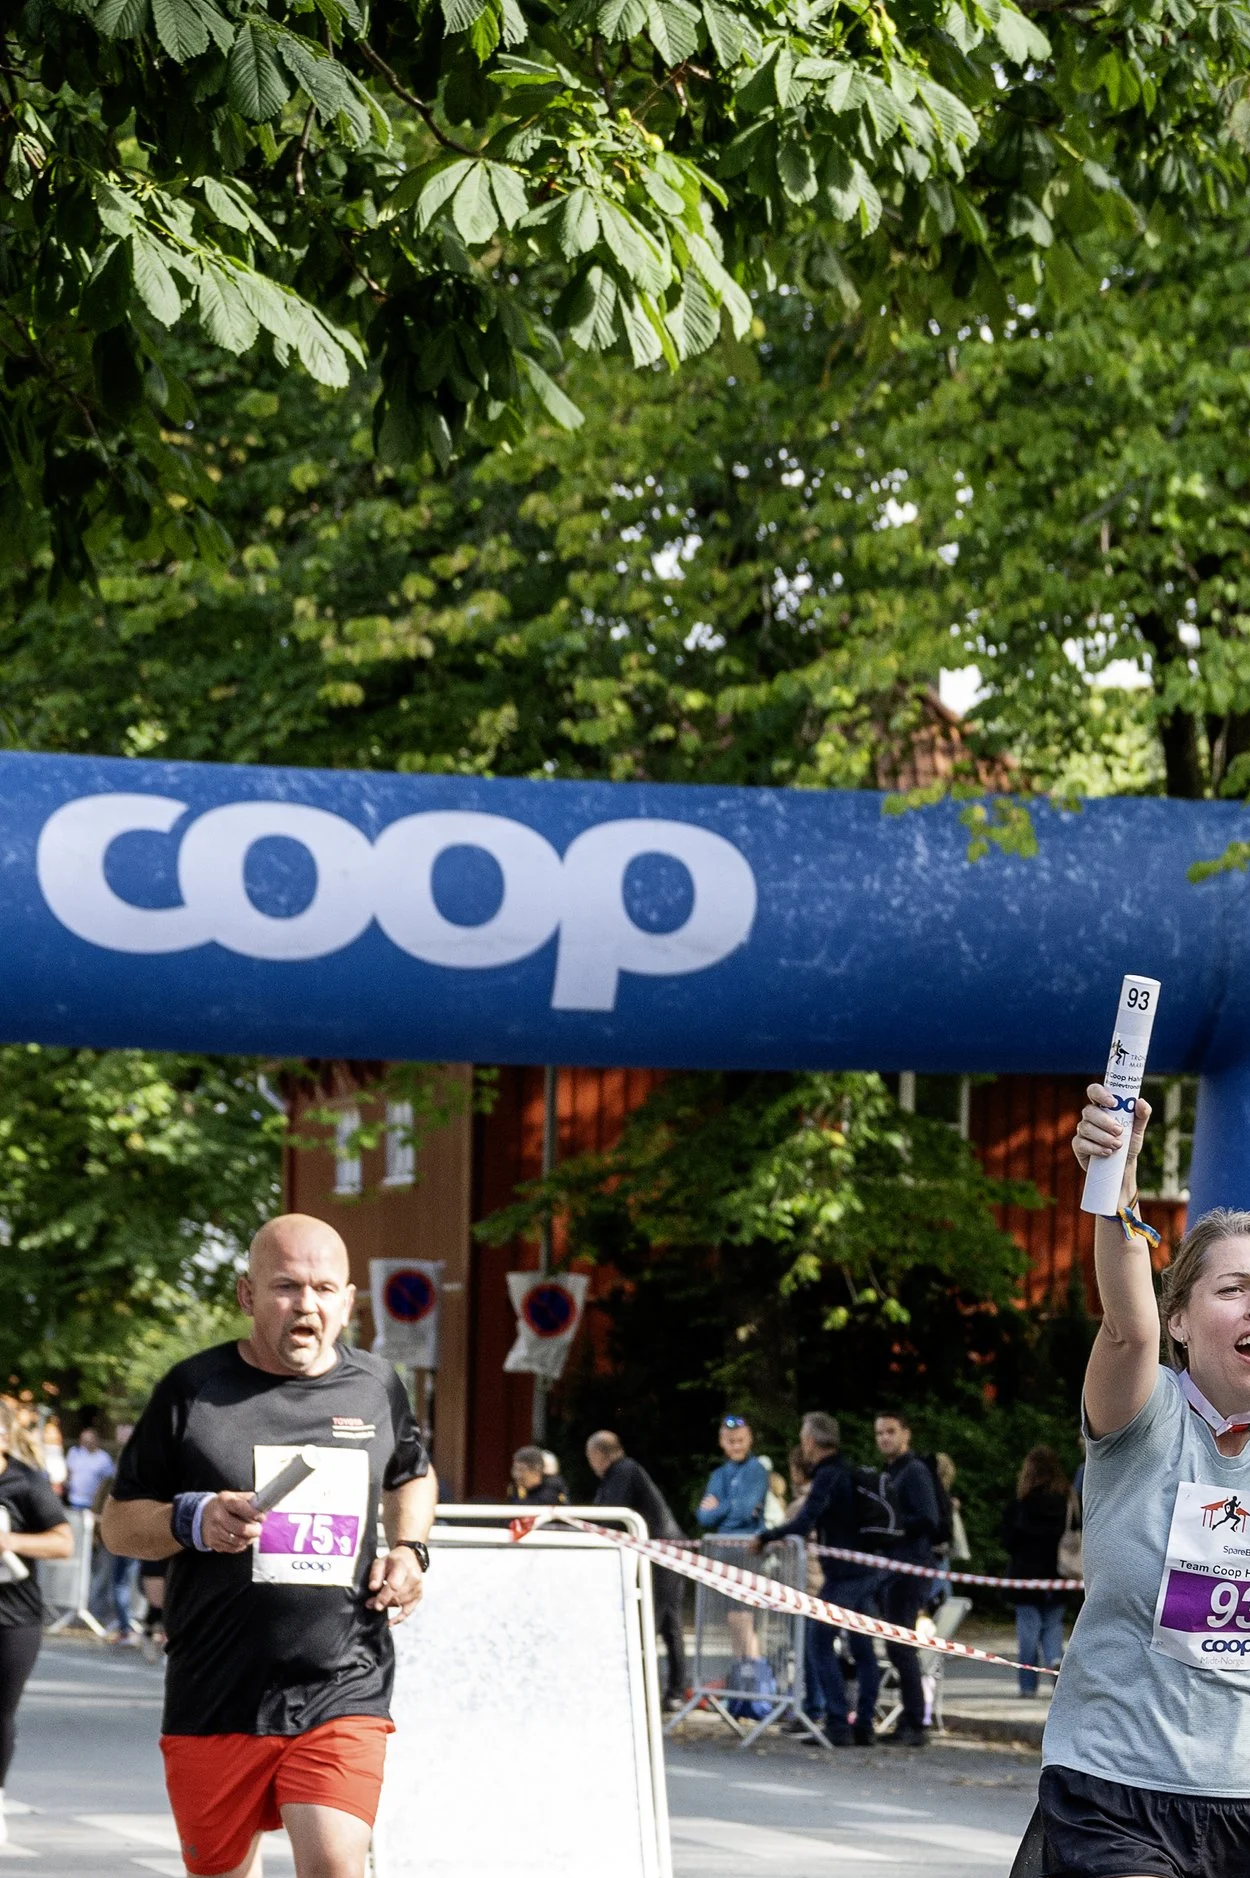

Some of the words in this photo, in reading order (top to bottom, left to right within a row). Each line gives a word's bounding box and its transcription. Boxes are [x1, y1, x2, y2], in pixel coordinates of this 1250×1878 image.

[37, 793, 758, 1011] coop
[1127, 987, 1150, 1010] 93
[288, 1513, 334, 1554] 75
[292, 1560, 331, 1572] coop
[1179, 1559, 1209, 1573] Team
[1213, 1565, 1242, 1578] Coop
